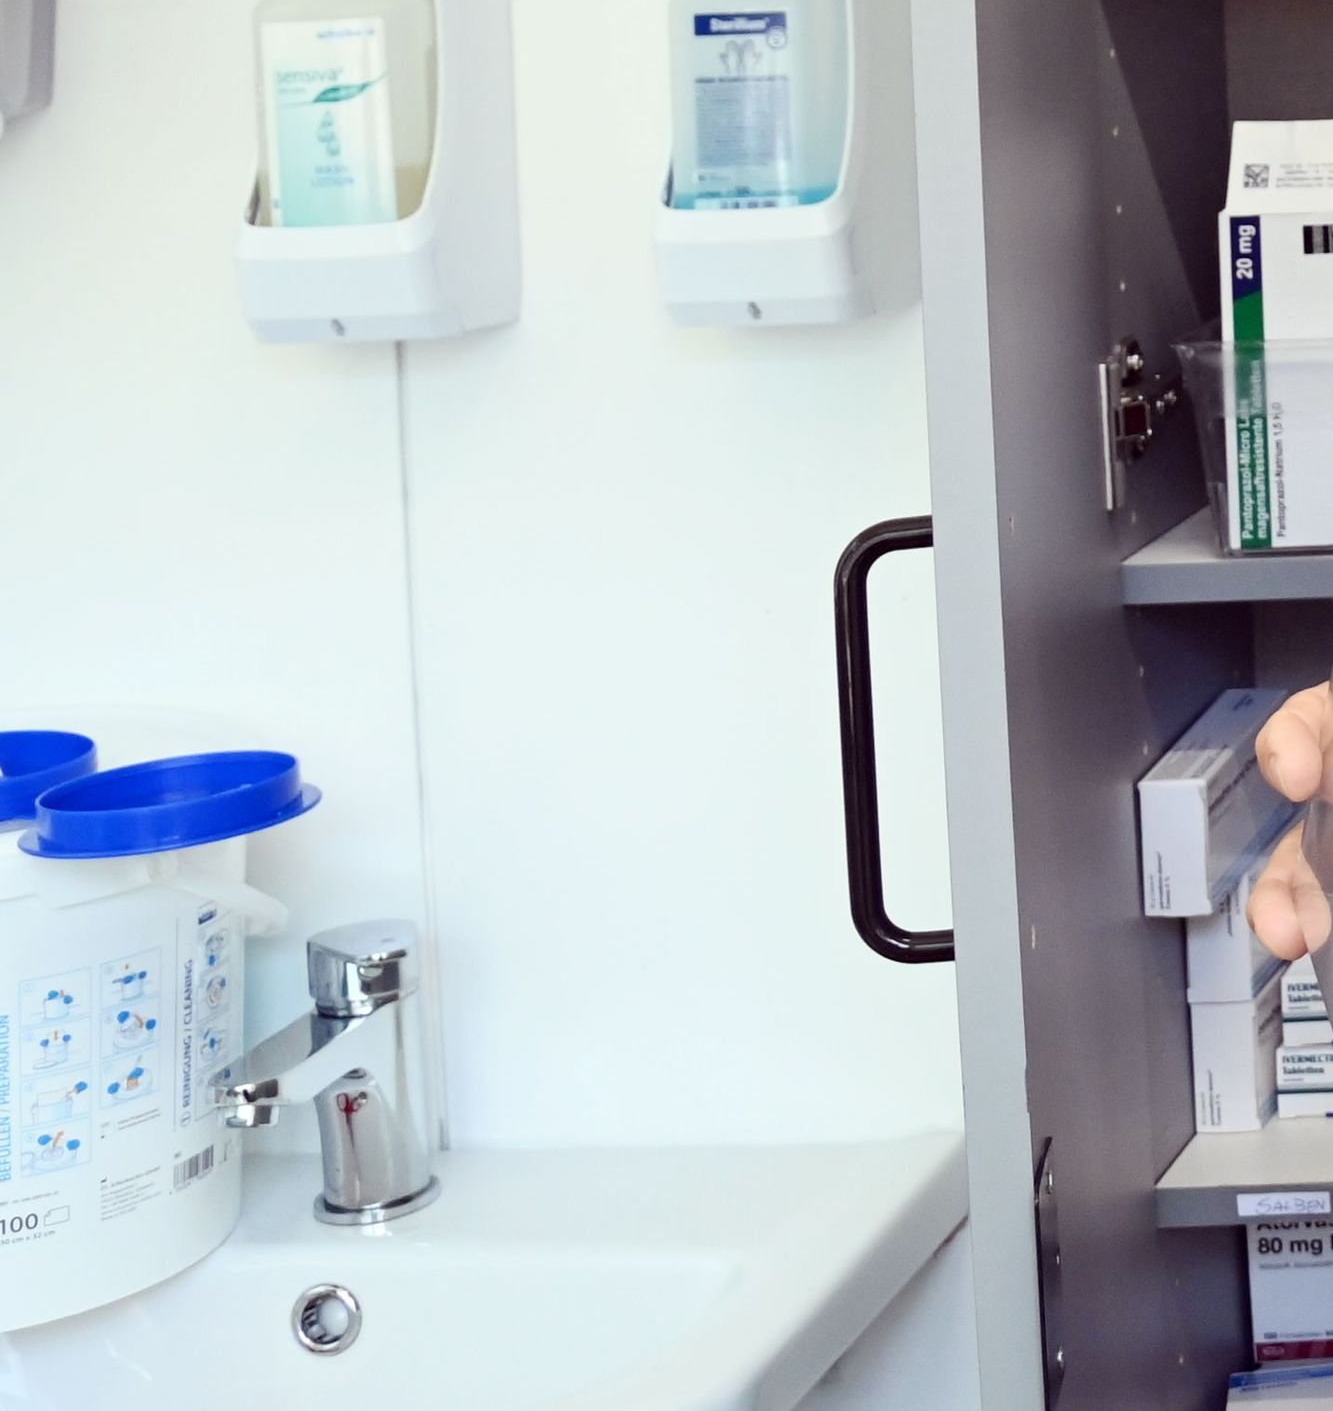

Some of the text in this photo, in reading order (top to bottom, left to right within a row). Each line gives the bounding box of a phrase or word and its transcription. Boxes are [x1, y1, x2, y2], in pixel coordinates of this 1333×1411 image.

[1234, 223, 1256, 279] 20 mg
[1237, 429, 1256, 539] Pantoprazol-Micro
[1248, 416, 1270, 539] magensaftresistente
[1270, 439, 1286, 537] Pantoprazol-Natrium
[181, 958, 194, 1025] CLEANING
[180, 1034, 193, 1109] REINIGUNG
[1257, 1236, 1284, 1255] 80
[1289, 1236, 1324, 1257] mg
